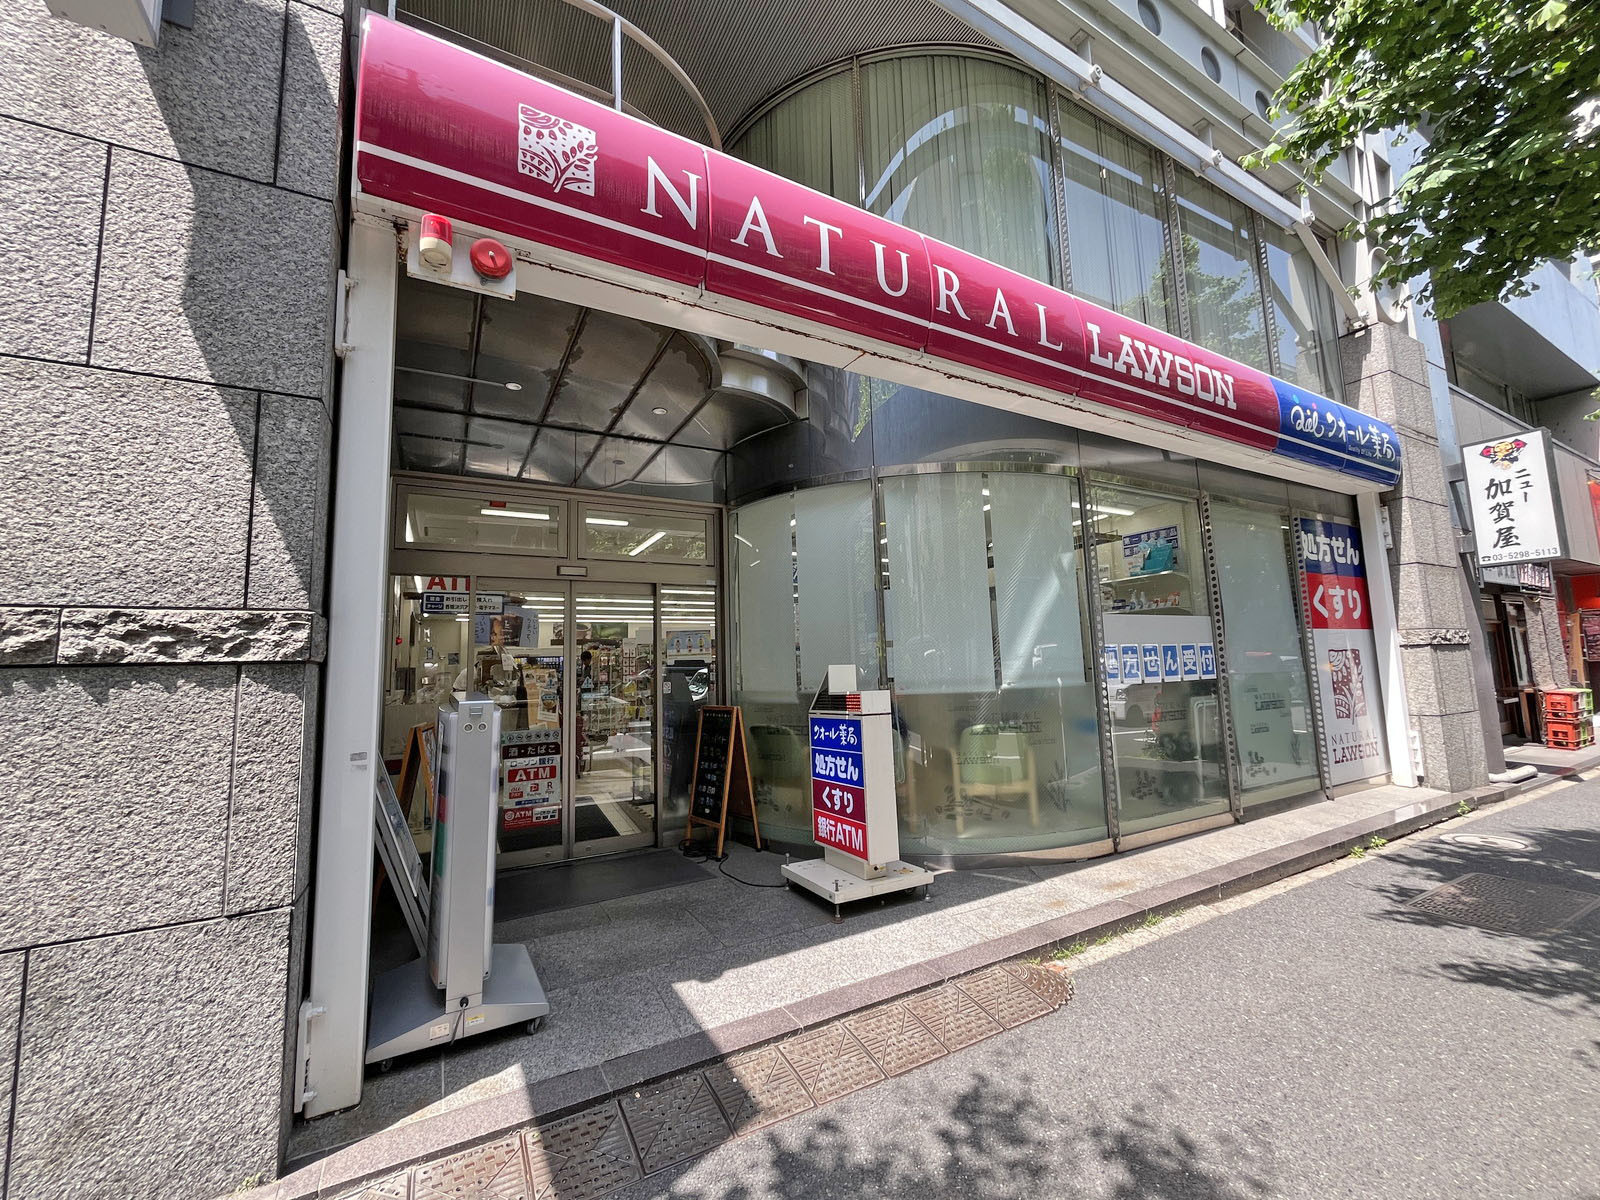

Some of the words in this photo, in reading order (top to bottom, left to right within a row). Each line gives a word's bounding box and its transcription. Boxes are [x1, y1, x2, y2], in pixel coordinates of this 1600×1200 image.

[640, 155, 1063, 352] NATURAL
[1086, 321, 1237, 411] LAWSON
[1326, 411, 1396, 462] クオール薬局
[1514, 468, 1534, 503] ニュー
[1484, 478, 1521, 549] 加賀屋
[1301, 530, 1360, 567] 処方せん
[1492, 547, 1558, 562] 03-5298-5113
[1312, 583, 1362, 621] くすり
[813, 723, 857, 746] クオール薬局
[1331, 729, 1378, 746] NATURAL
[508, 745, 556, 757] 酒・たばこ
[510, 758, 555, 767] ローソン銀行
[1333, 741, 1380, 765] LAWSON
[514, 767, 551, 782] ATM
[815, 752, 859, 781] 処方せん
[821, 786, 854, 814] くすり
[515, 810, 532, 819] ATM
[817, 815, 863, 852] 銀行ATM
